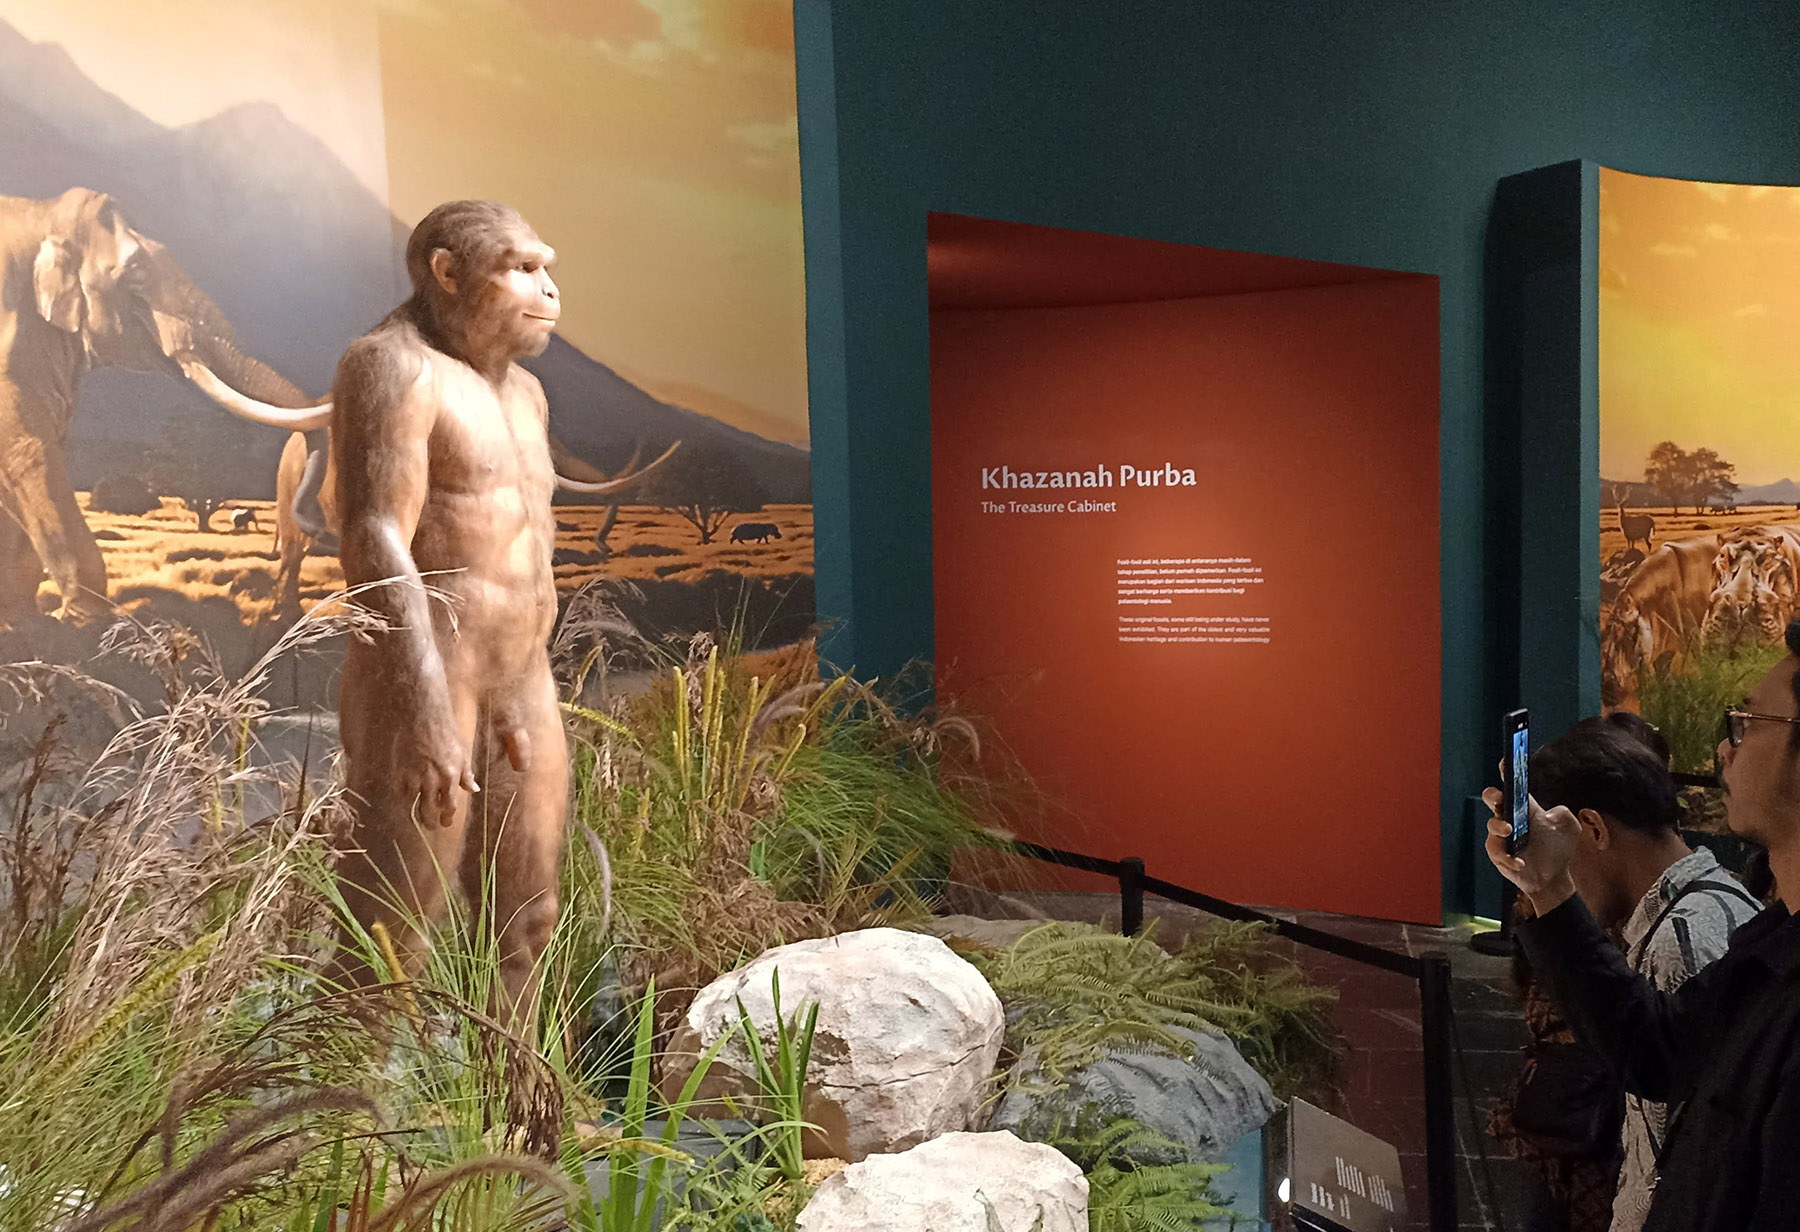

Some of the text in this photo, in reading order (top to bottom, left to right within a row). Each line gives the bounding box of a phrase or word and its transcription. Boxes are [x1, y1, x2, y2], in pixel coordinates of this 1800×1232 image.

[981, 462, 1197, 489] Khazanah Purba
[981, 499, 1116, 514] The Treasure Cabinet
